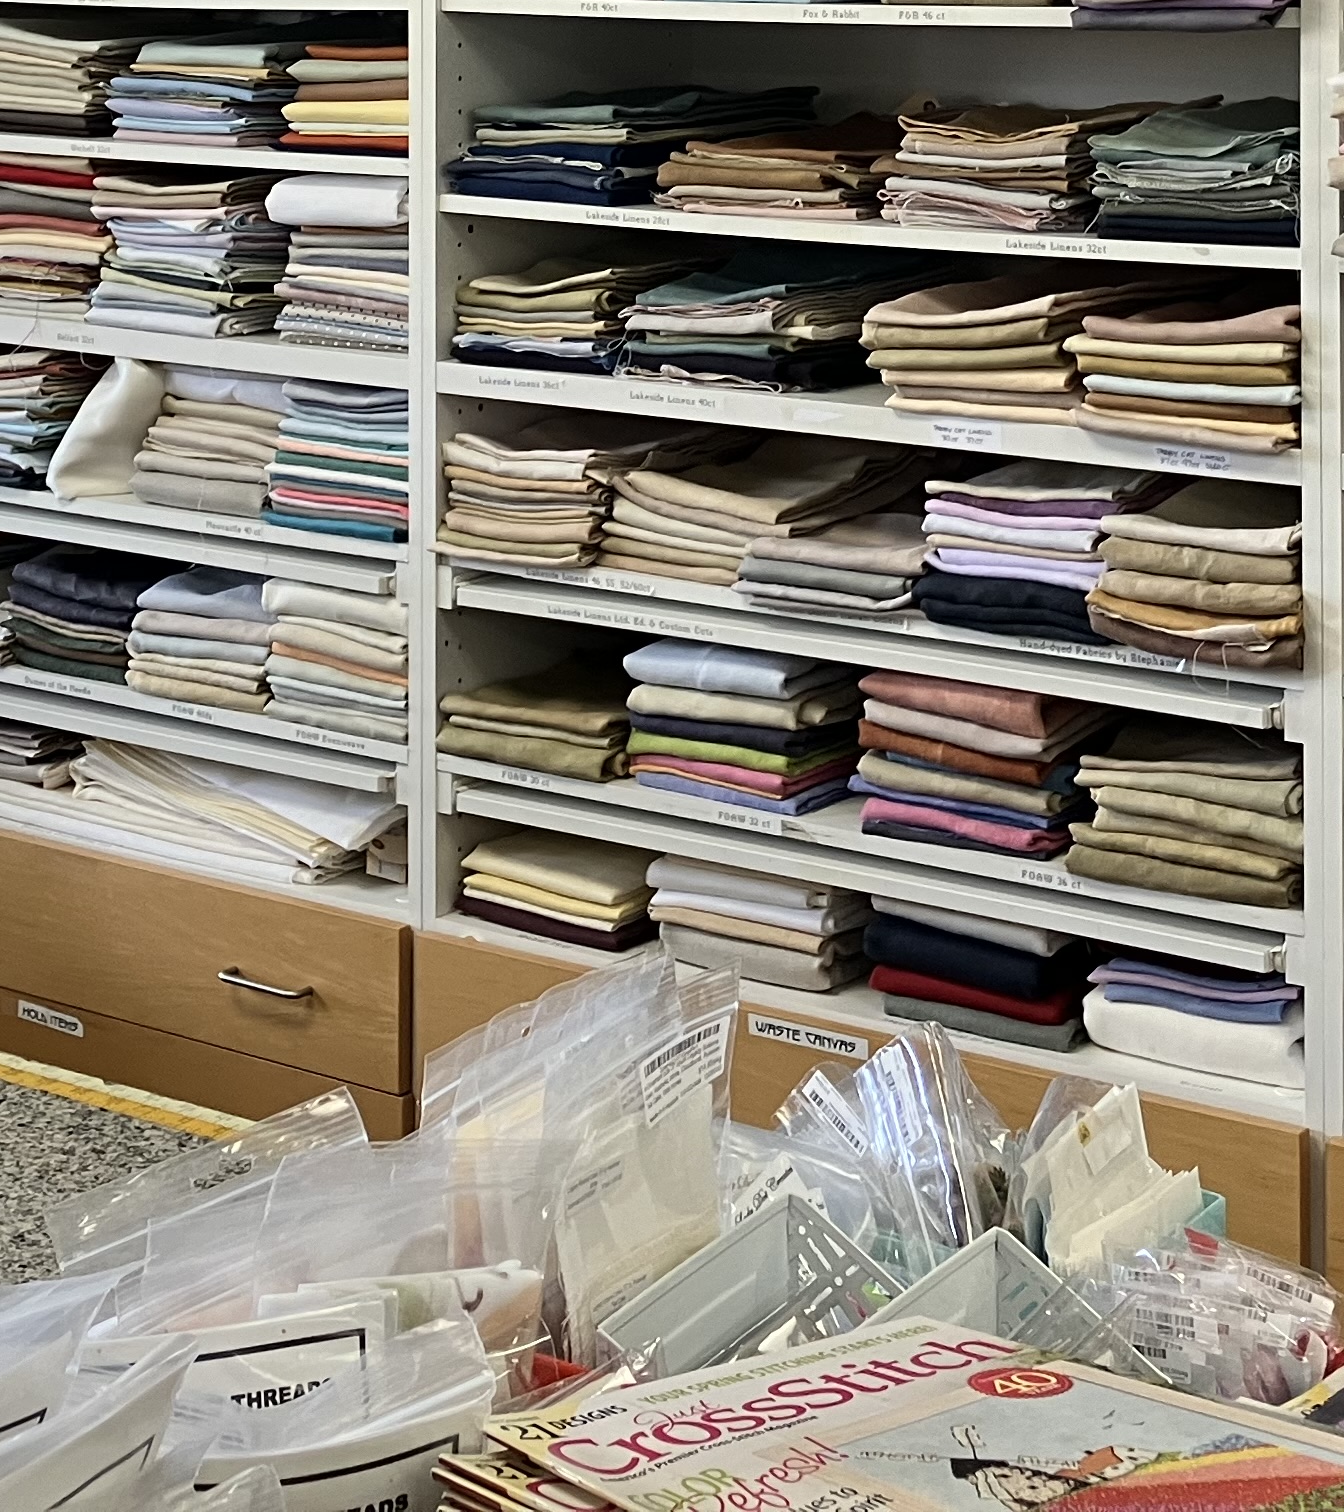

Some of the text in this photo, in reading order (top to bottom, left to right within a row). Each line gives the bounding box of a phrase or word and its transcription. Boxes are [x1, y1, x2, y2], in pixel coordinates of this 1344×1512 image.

[802, 9, 819, 19] Fox
[831, 9, 860, 20] Rabbit
[1005, 238, 1107, 256] Lakeside Linens 32ct
[1114, 650, 1127, 664] by
[755, 1020, 856, 1054] WASTE CANVAS
[230, 1377, 332, 1410] THREA
[638, 1387, 693, 1406] YOUR
[690, 1372, 755, 1393] SPRING
[747, 1351, 837, 1380] STITCHING
[993, 1371, 1059, 1395] 40
[500, 1404, 628, 1440] 21 DESIGNS
[547, 1339, 1023, 1476] CrossStitch
